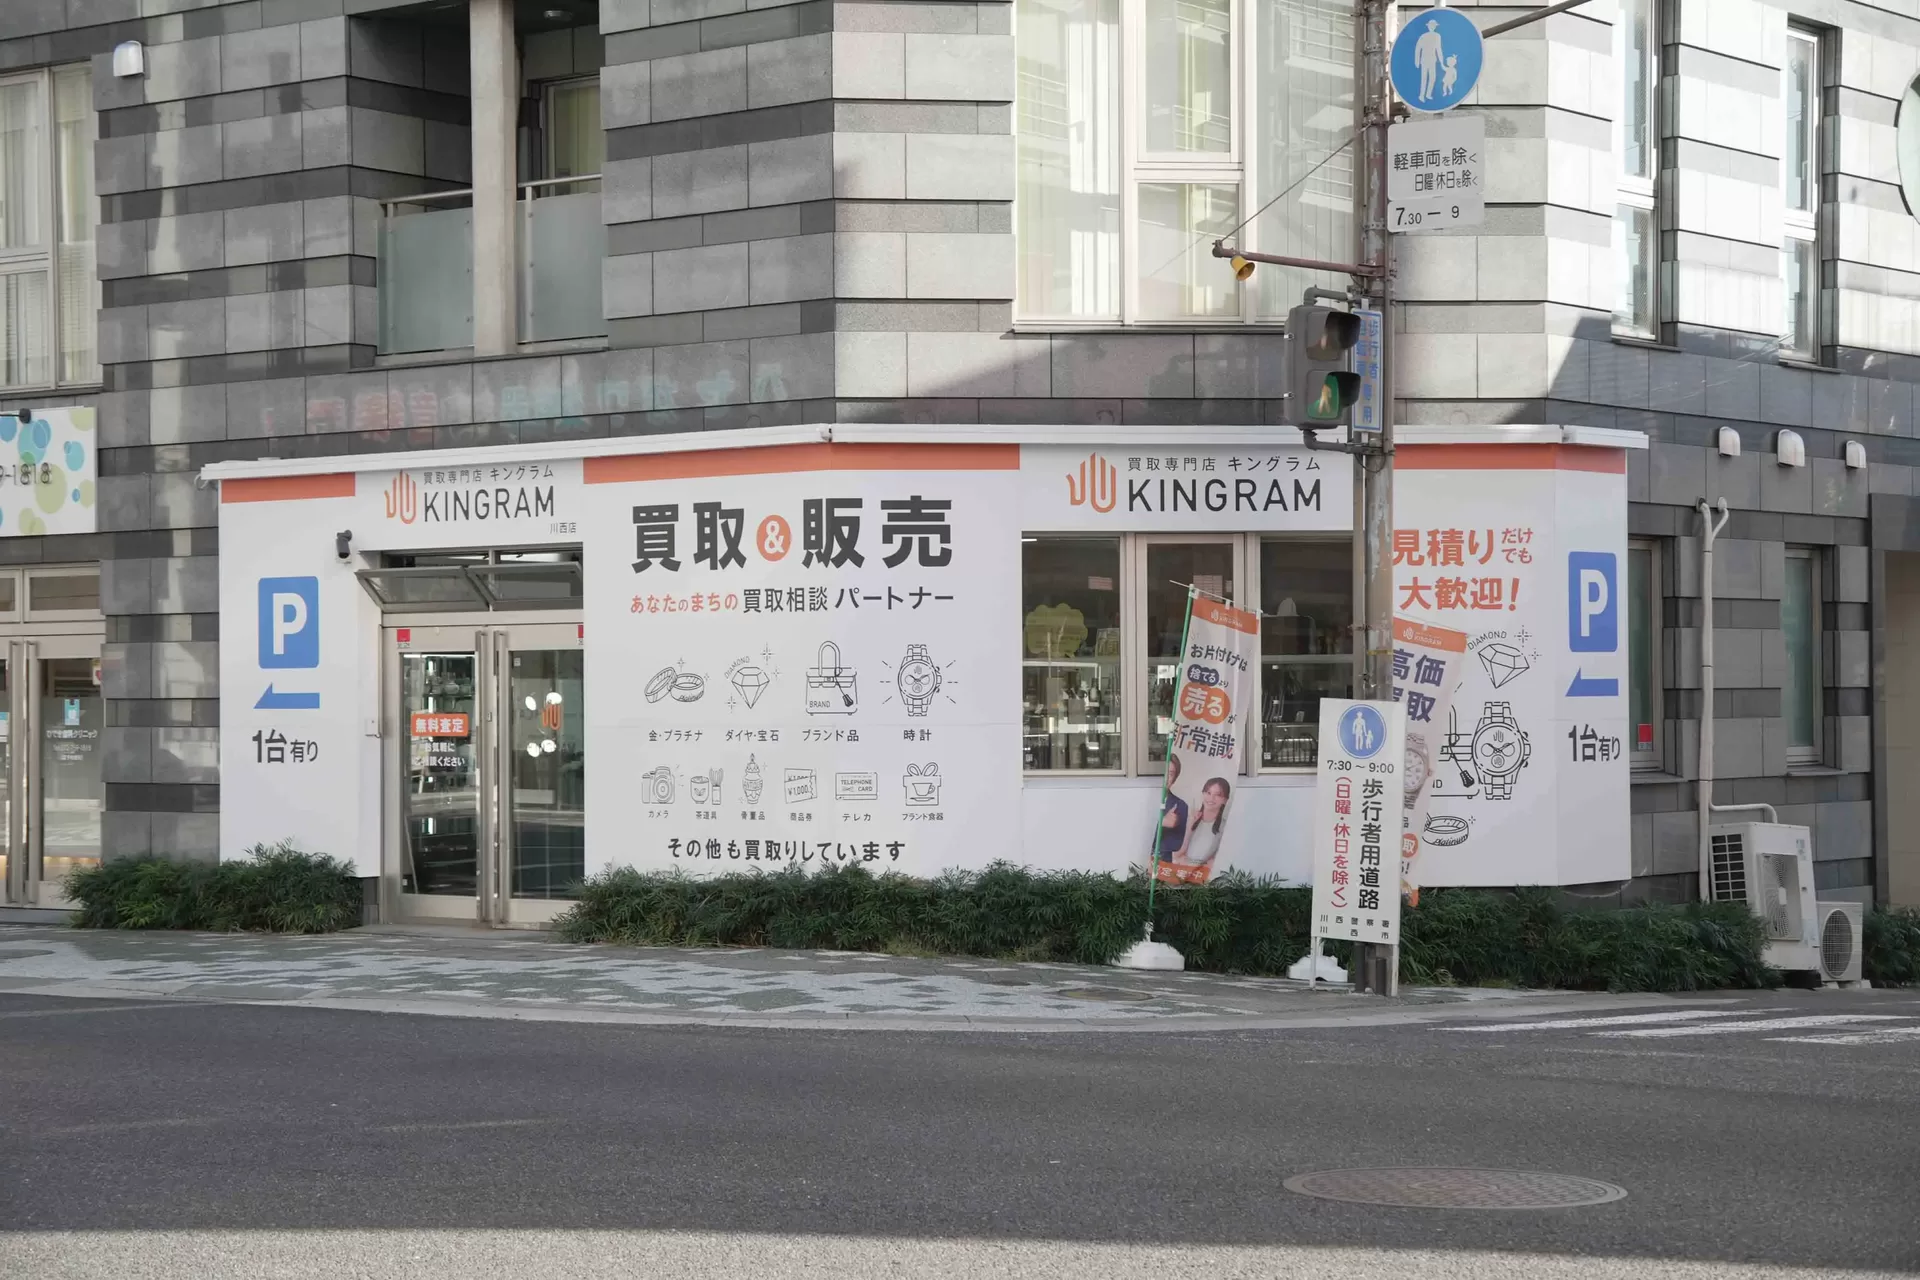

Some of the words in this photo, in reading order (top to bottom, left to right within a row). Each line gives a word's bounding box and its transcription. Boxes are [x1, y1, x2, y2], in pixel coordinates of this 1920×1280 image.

[1394, 147, 1477, 171] 軽車両を除く
[1396, 208, 1422, 225] 7.30
[1452, 206, 1459, 219] 9
[1128, 457, 1217, 472] 買取専門店
[1228, 456, 1321, 472] キングラム
[424, 469, 483, 485] 買取専門店
[490, 465, 554, 481] キングラム
[424, 485, 554, 522] KINGRAM
[1128, 479, 1321, 512] KINGRAM
[550, 522, 577, 534] 川西店
[1502, 528, 1533, 545] だけ
[1502, 547, 1533, 564] でも
[1399, 576, 1520, 612] 大歓迎!
[1580, 569, 1608, 637] P
[273, 593, 307, 655] P
[1467, 630, 1507, 651] DIAMOND
[1190, 644, 1248, 671] お片付けは
[1393, 648, 1447, 688] 高価
[809, 700, 831, 708] BRAND
[415, 718, 464, 733] 無料査定
[725, 729, 779, 742] ダイヤ・宝石
[802, 729, 859, 742] ブランド品
[903, 729, 932, 742] 時計
[1568, 724, 1621, 762] 1台有り
[252, 729, 319, 763] 1台有り
[1326, 759, 1352, 771] 7:30
[1368, 761, 1395, 774] 9:00
[648, 810, 669, 819] カメラ
[842, 813, 872, 822] テレカ
[1358, 778, 1383, 911] 歩行者用道路
[1433, 834, 1469, 846] Platinum
[668, 838, 906, 862] その他も買取りしています
